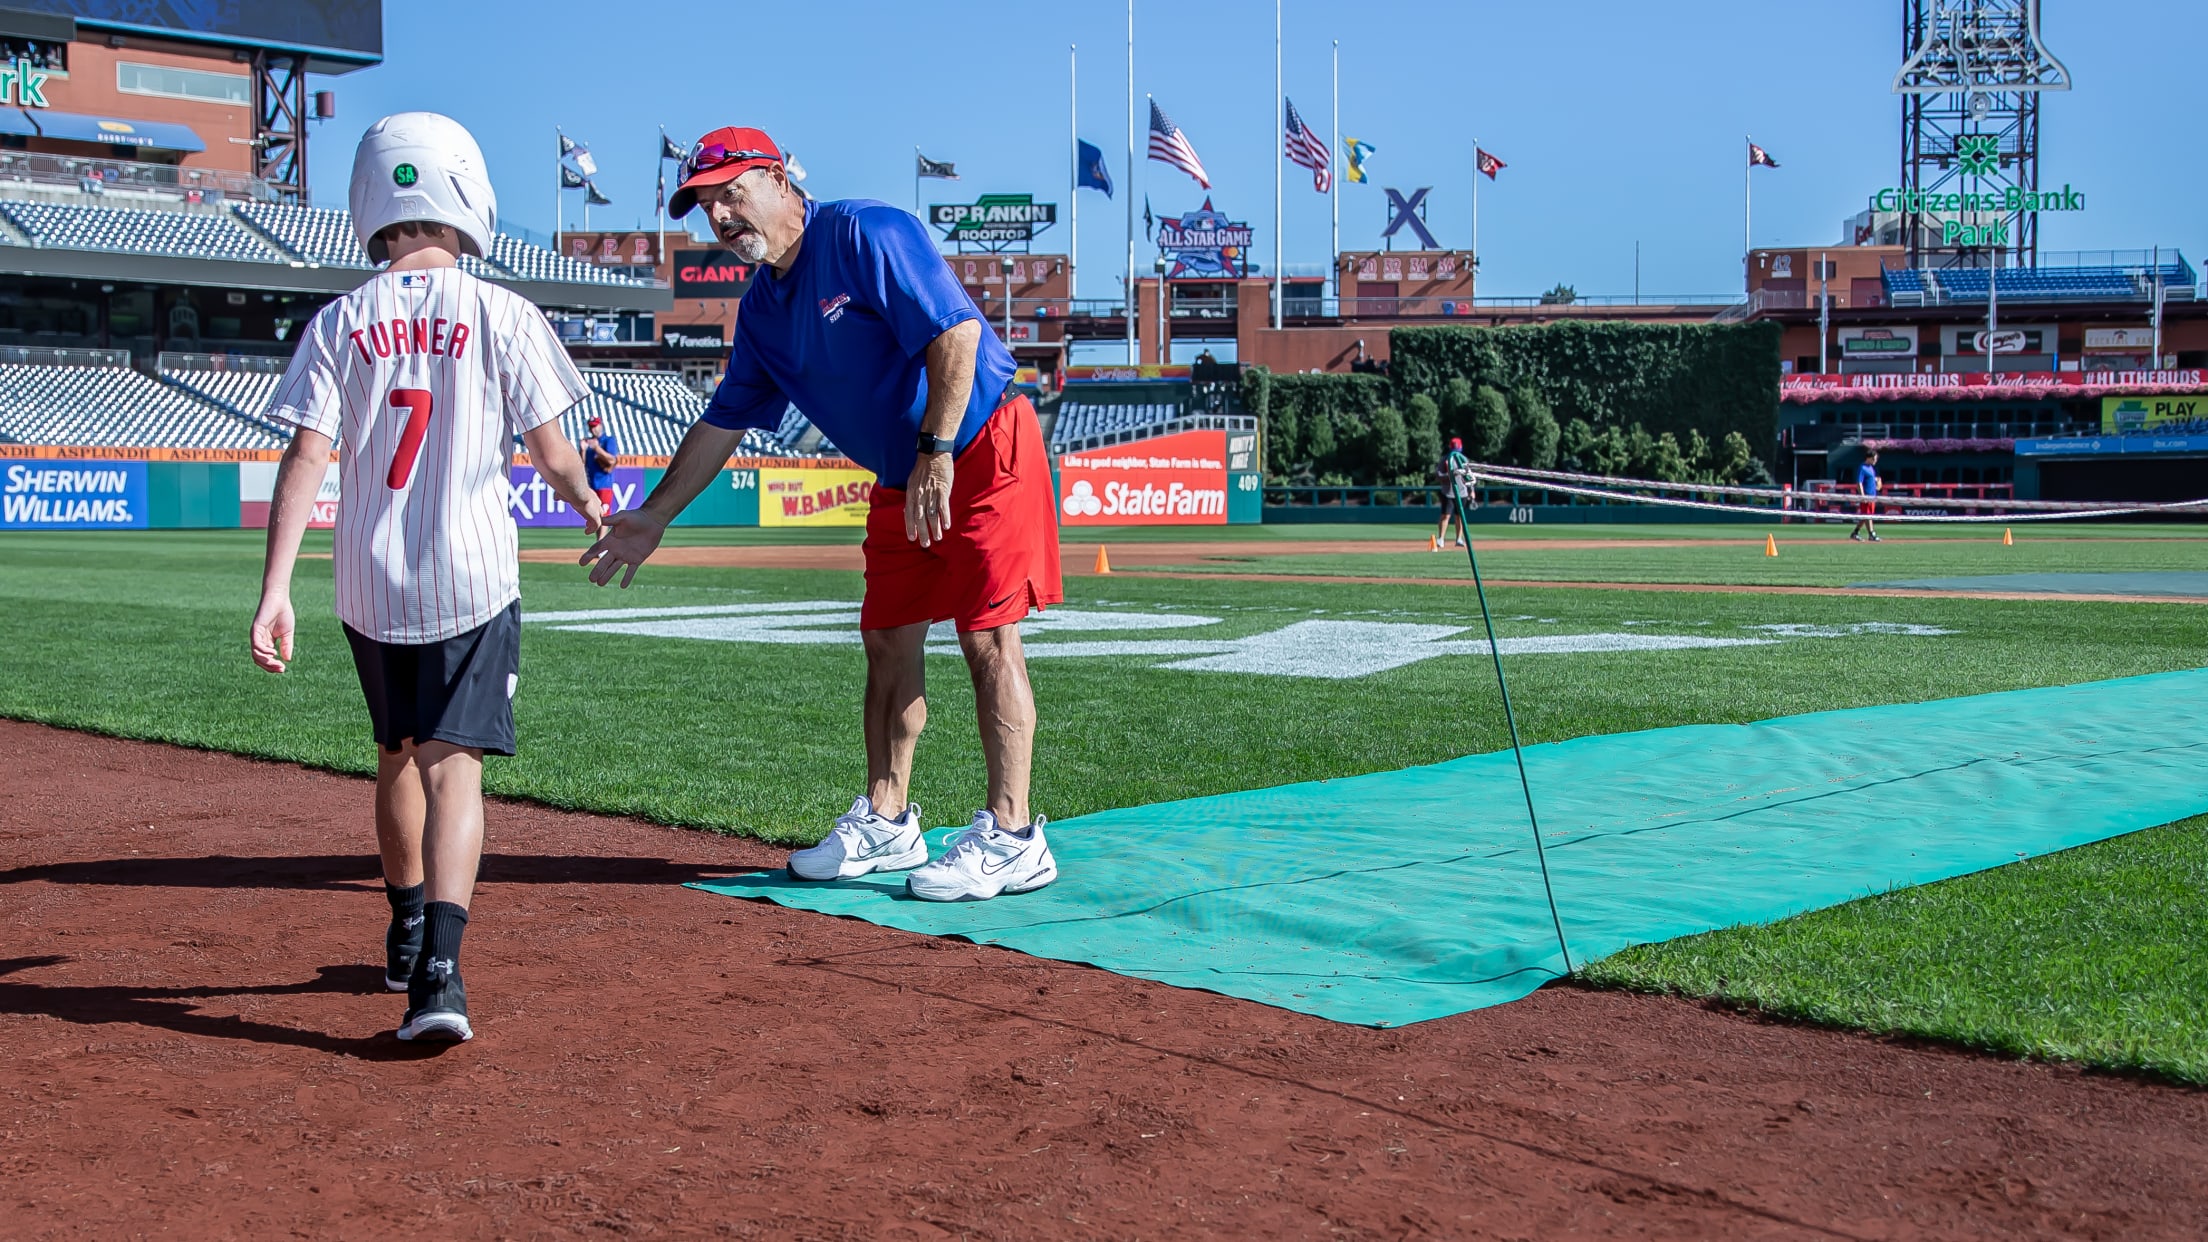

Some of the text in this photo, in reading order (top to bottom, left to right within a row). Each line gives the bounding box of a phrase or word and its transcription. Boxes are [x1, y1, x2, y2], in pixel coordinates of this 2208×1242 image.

[396, 166, 416, 184] SA
[1875, 184, 2081, 213] Citizens Bank
[938, 206, 968, 222] CP
[959, 229, 1027, 241] ROOFTOP
[1158, 228, 1251, 246] ALL STAR GAME
[1943, 218, 2010, 247] Park
[1772, 255, 1791, 271] 42
[680, 266, 749, 283] GIANT
[349, 317, 470, 366] TURNER
[2155, 402, 2197, 417] PLAY
[386, 388, 434, 490] 7
[56, 447, 151, 459] ASPLUNDH
[170, 449, 260, 461] ASPLUNDH
[735, 458, 801, 469] ASPLUNDH
[1065, 456, 1083, 468] Like
[1091, 457, 1111, 470] good
[1149, 457, 1171, 468] State
[1171, 458, 1191, 469] Farm
[5, 465, 127, 493] SHERWIN
[731, 471, 756, 490] 374
[1238, 475, 1259, 492] 409
[782, 481, 872, 517] W.B.MASO
[3, 495, 133, 523] WILLIAMS.
[1509, 508, 1533, 523] 401
